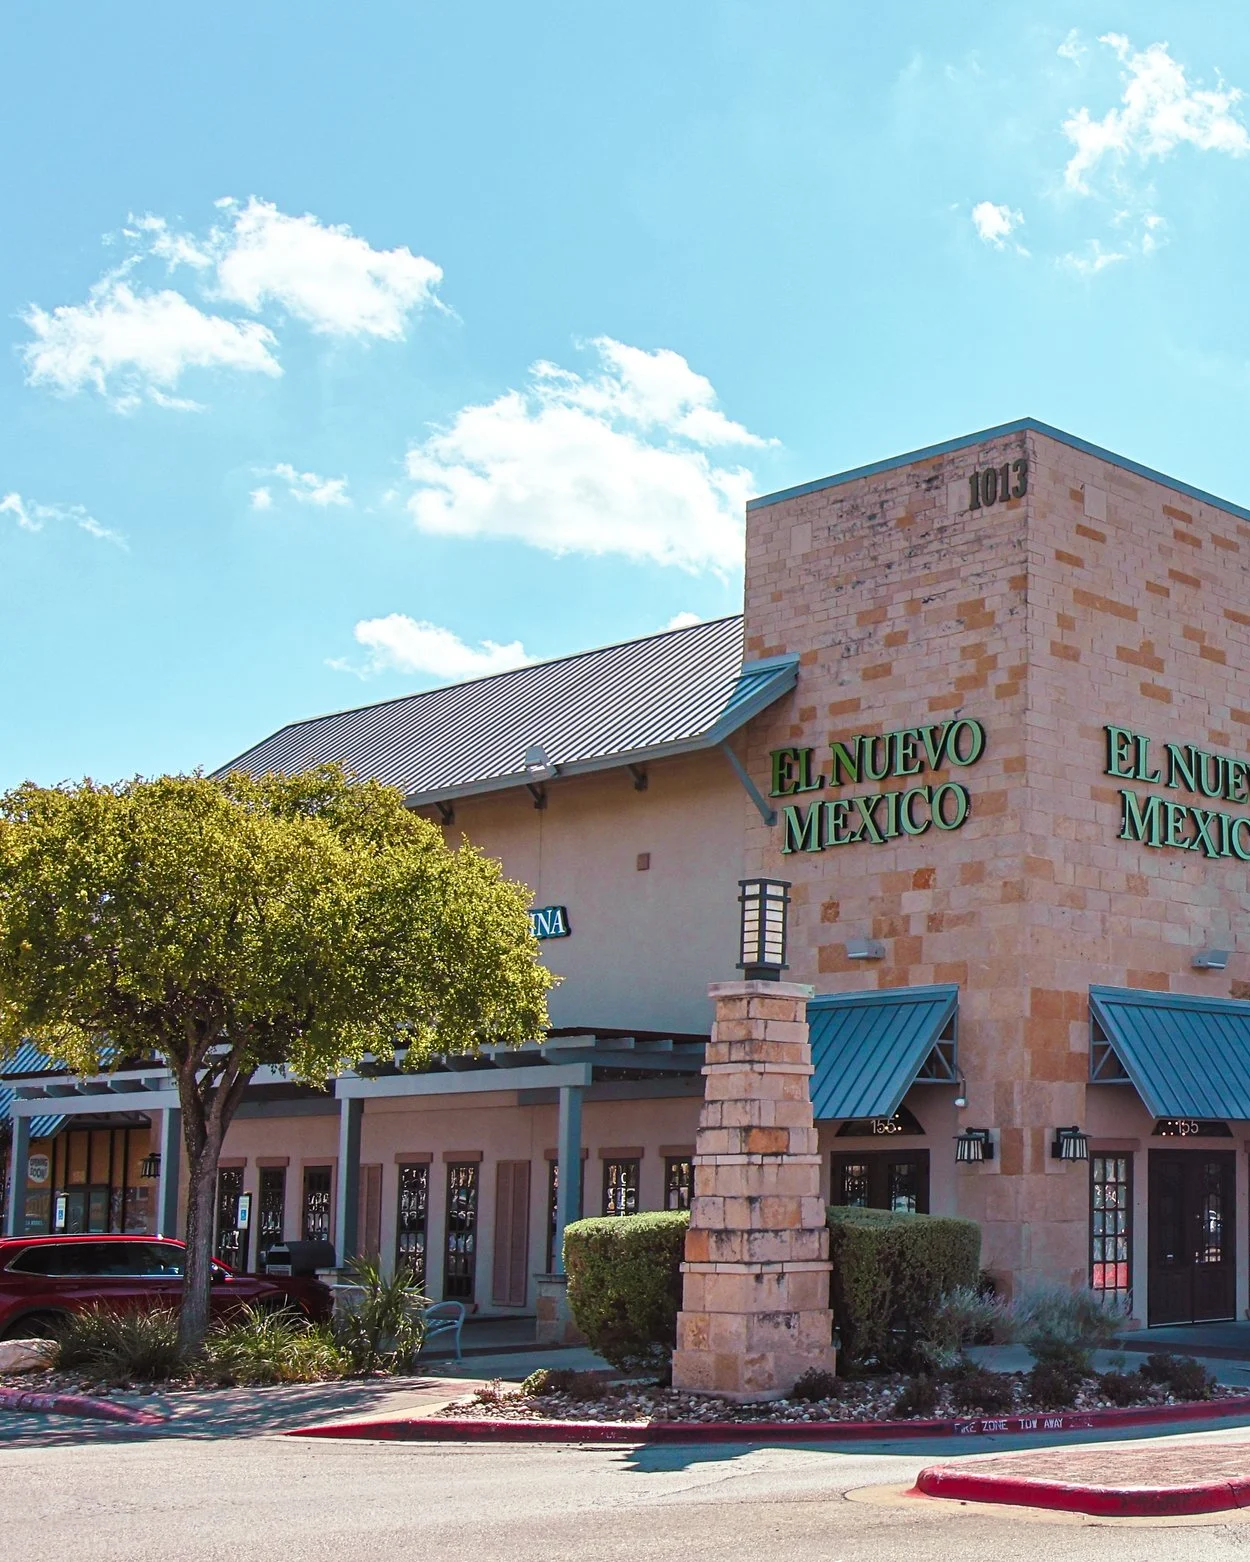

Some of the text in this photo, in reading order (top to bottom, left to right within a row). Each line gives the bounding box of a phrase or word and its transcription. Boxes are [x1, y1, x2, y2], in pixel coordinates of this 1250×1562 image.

[969, 458, 1028, 511] 1013
[768, 718, 986, 797] EL NUEVO
[1104, 725, 1161, 783] EL
[781, 781, 971, 854] MEXICO
[870, 1117, 896, 1133] 155
[1177, 1119, 1199, 1134] 155
[982, 1419, 1008, 1432] ZONE
[1018, 1418, 1037, 1429] TOW
[1044, 1417, 1063, 1429] AWAY
